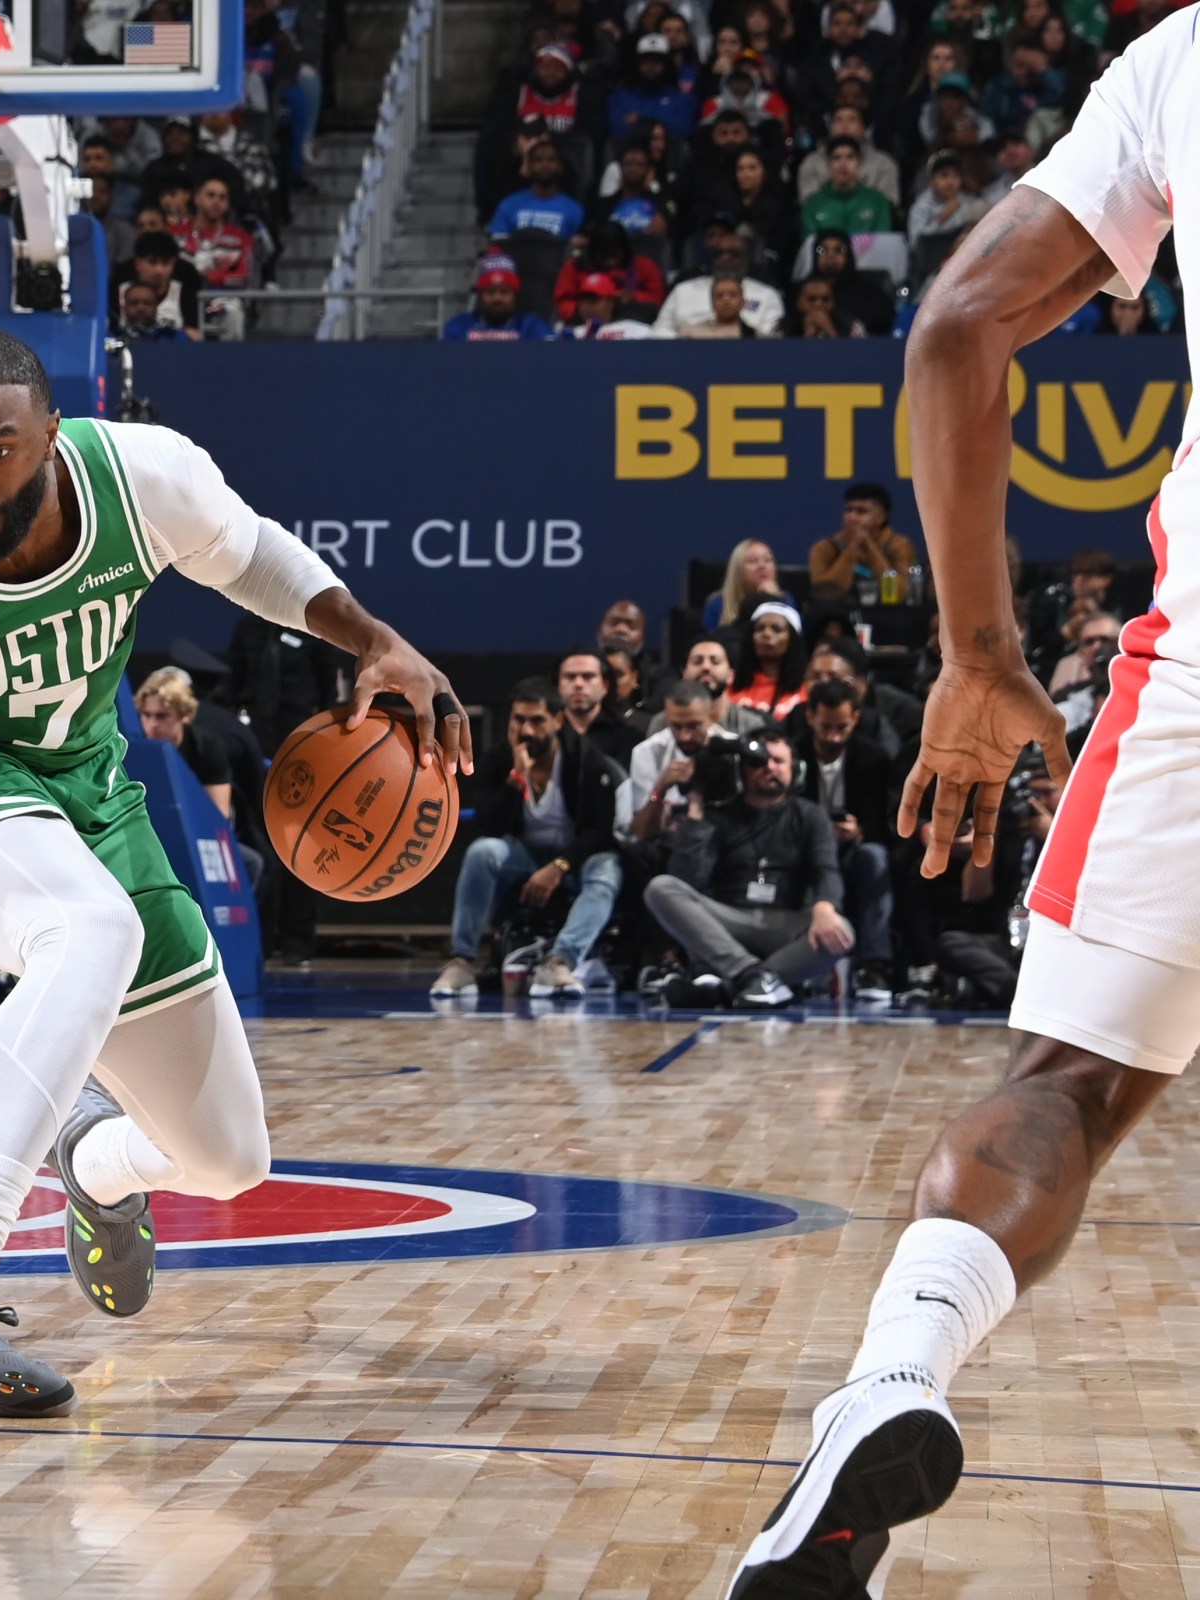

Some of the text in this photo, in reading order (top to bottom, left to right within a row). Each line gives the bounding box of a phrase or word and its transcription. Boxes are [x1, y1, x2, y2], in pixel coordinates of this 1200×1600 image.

[294, 519, 584, 568] RT CLUB
[77, 562, 135, 593] Amica
[8, 675, 89, 750] 7
[351, 798, 444, 897] Wilson
